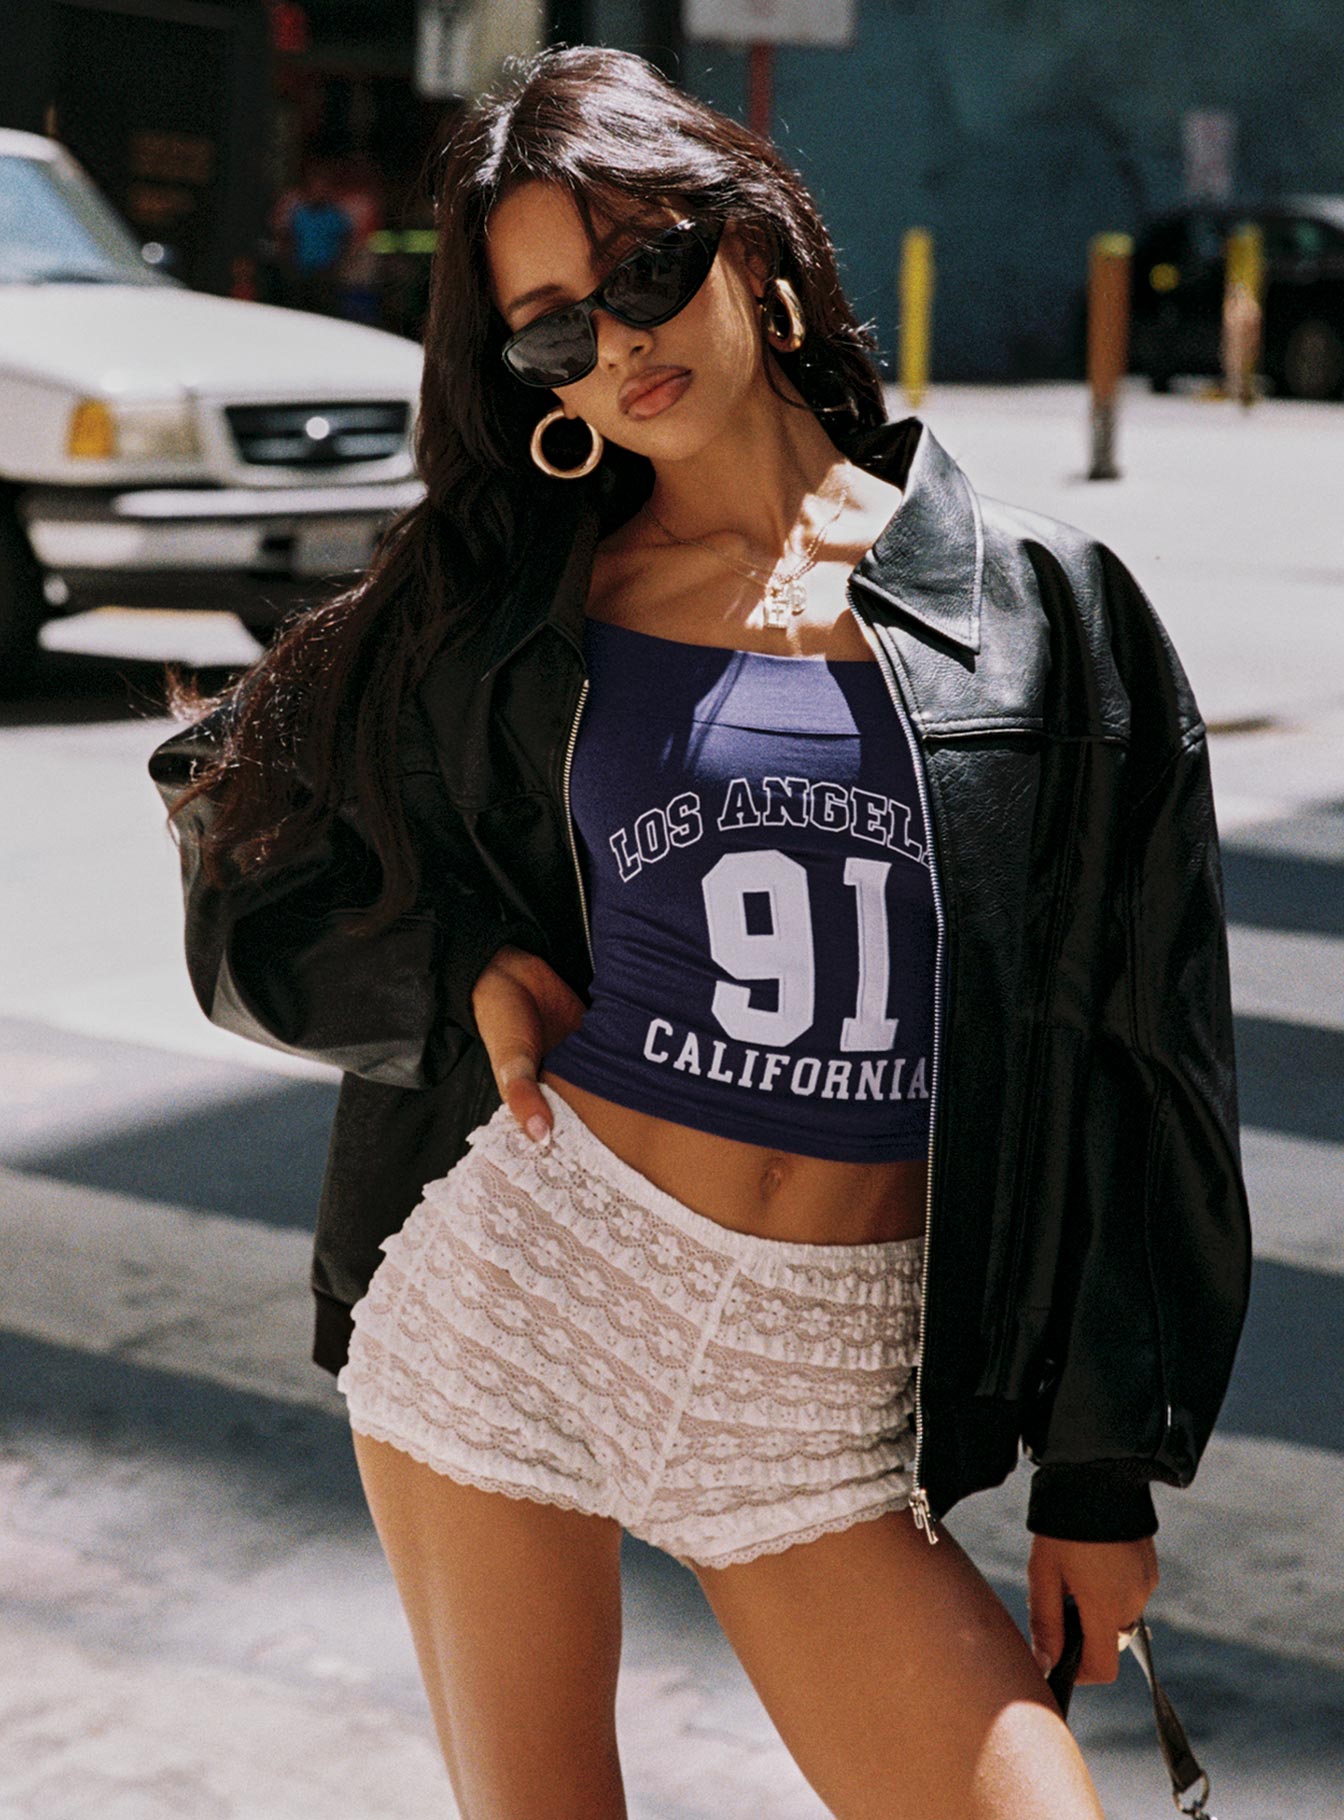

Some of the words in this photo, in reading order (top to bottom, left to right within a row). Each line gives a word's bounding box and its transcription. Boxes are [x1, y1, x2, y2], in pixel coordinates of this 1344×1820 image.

[610, 792, 703, 882] LOS
[717, 777, 931, 869] ANGEL
[702, 849, 899, 1052] 91
[643, 1018, 929, 1101] CALIFORNIA
